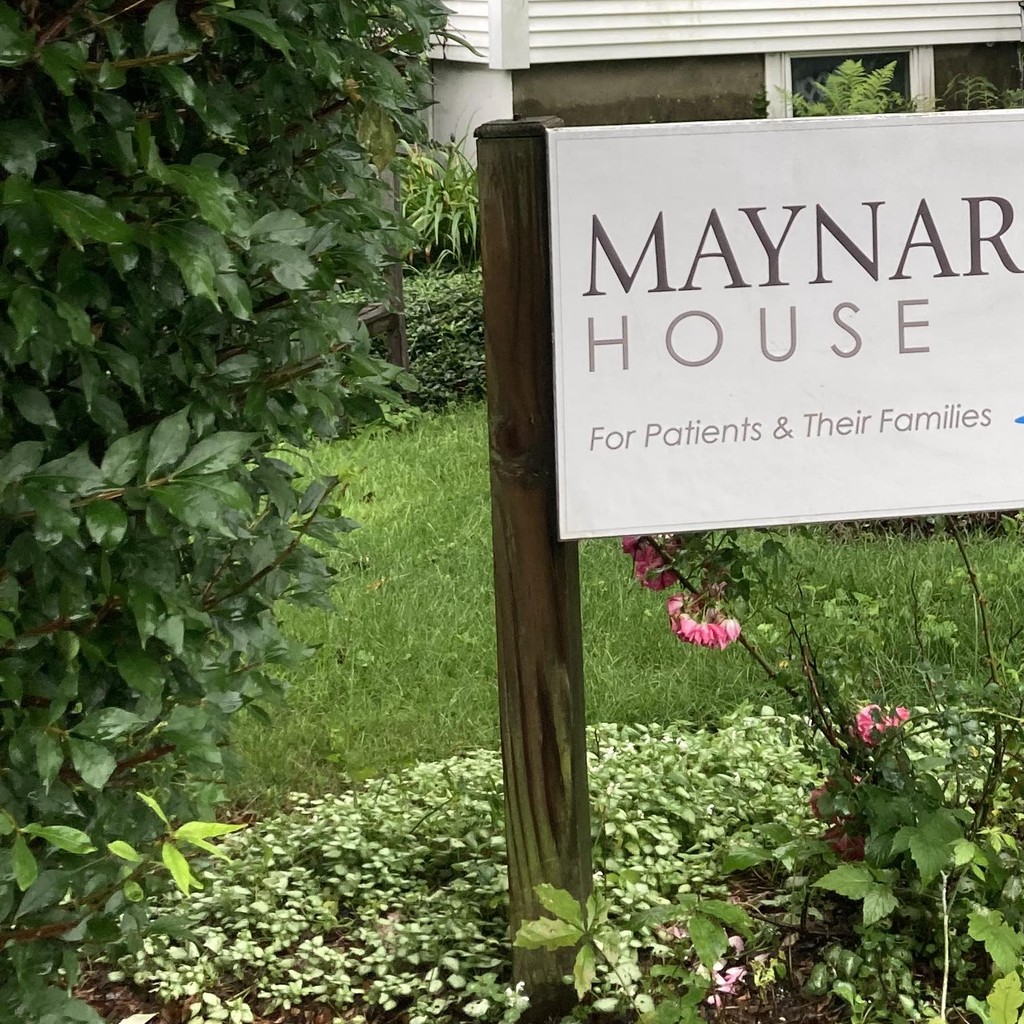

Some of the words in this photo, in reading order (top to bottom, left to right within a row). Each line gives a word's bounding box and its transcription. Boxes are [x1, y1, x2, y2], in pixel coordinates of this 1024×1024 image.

[587, 298, 930, 373] HOUSE
[590, 426, 637, 452] For
[644, 417, 762, 448] Patients
[773, 416, 795, 441] &
[803, 409, 873, 438] Their
[879, 404, 993, 433] Families
